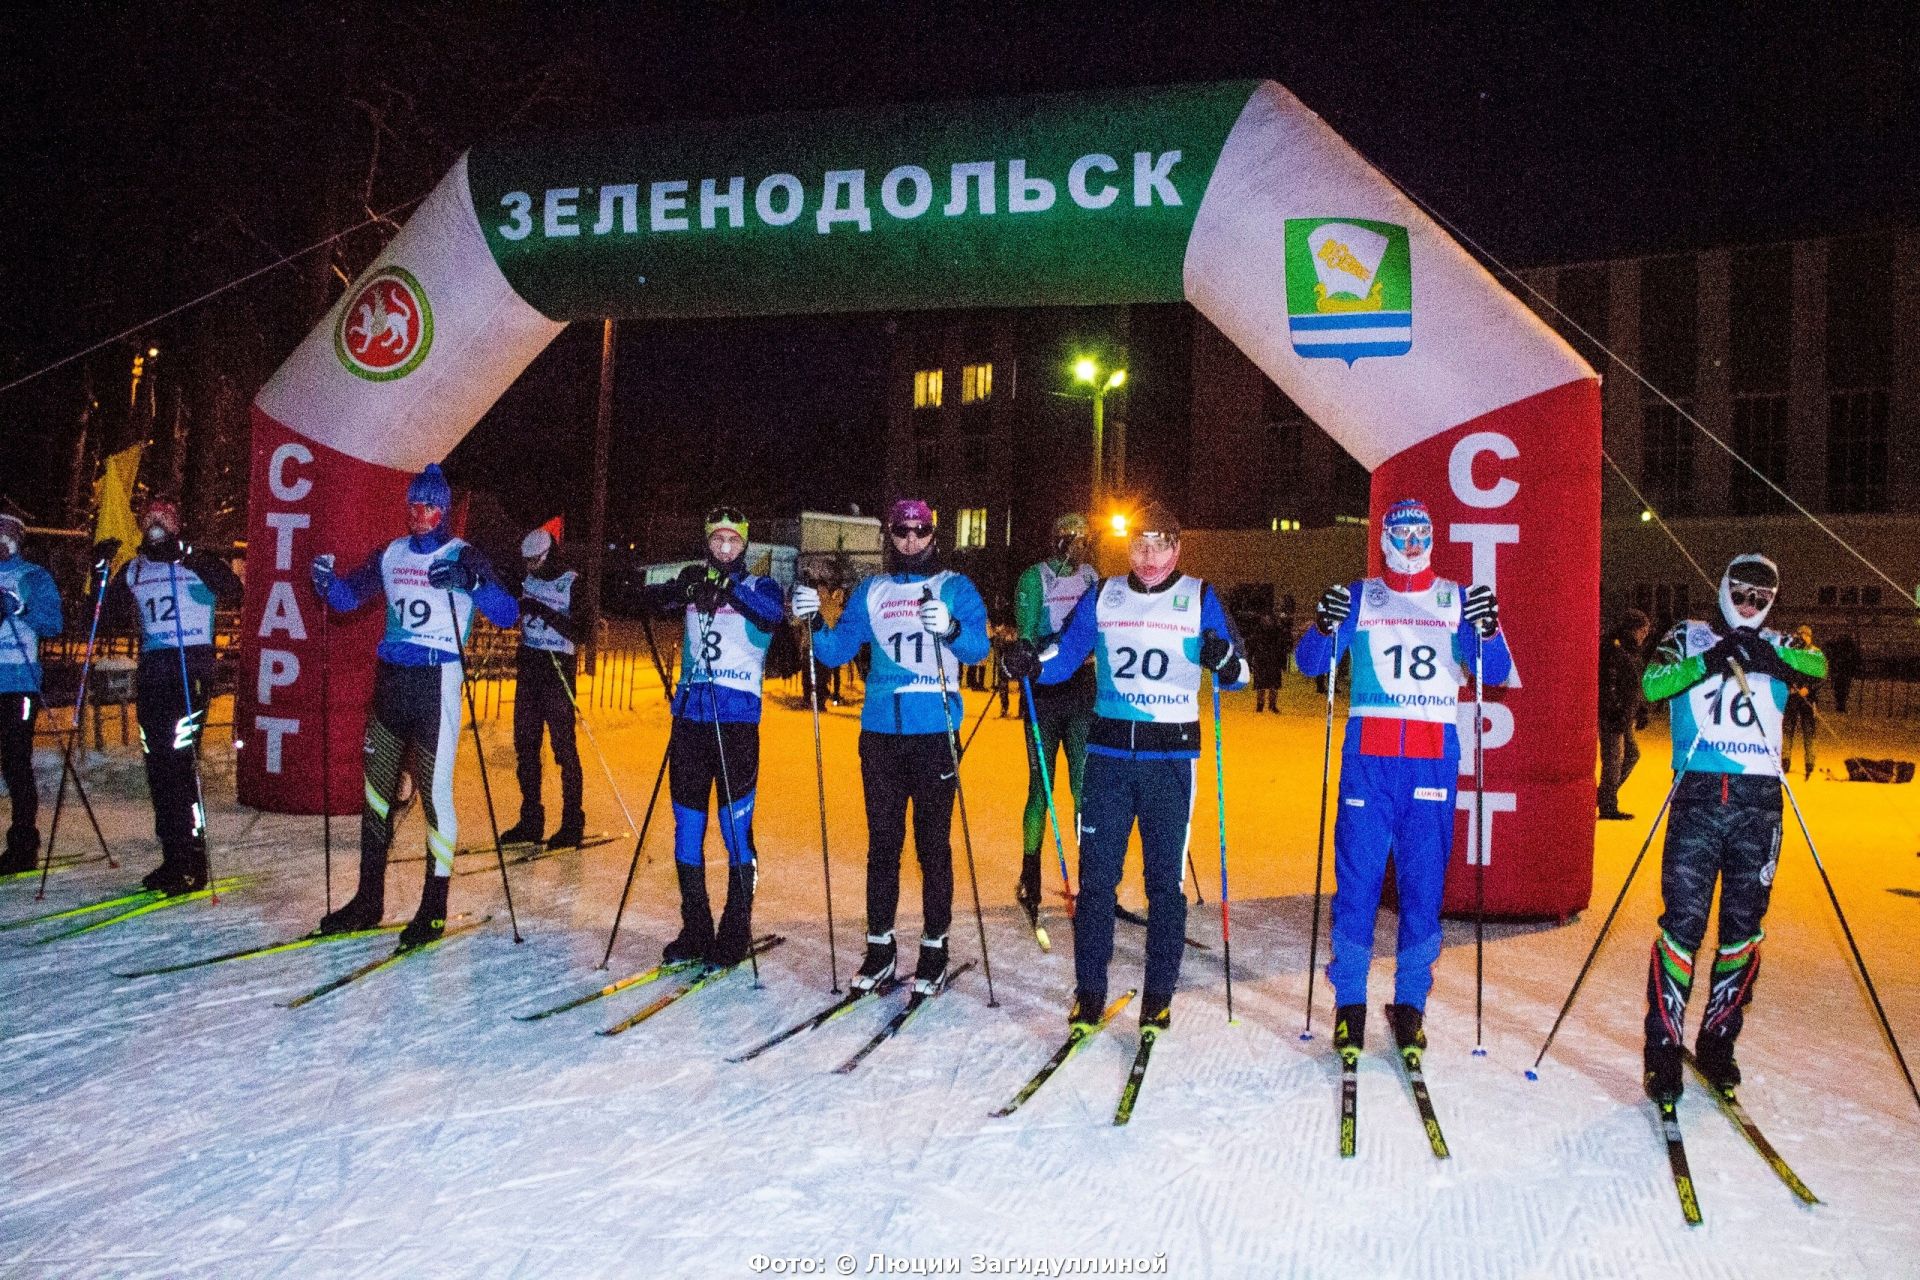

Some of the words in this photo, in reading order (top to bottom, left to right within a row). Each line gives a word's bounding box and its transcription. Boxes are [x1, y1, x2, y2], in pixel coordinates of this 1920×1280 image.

[499, 149, 1183, 241] ЗЕЛЕНОДОЛЬСК
[145, 596, 177, 623] 12
[255, 443, 314, 774] СТАРТ
[395, 598, 432, 628] 19
[883, 610, 914, 619] ШКОЛА
[1416, 619, 1446, 627] ШКОЛА
[1147, 622, 1178, 631] ШКОЛА
[888, 631, 923, 663] 11
[1113, 646, 1169, 680] 20
[1383, 644, 1437, 681] 18
[1704, 689, 1757, 727] 16
